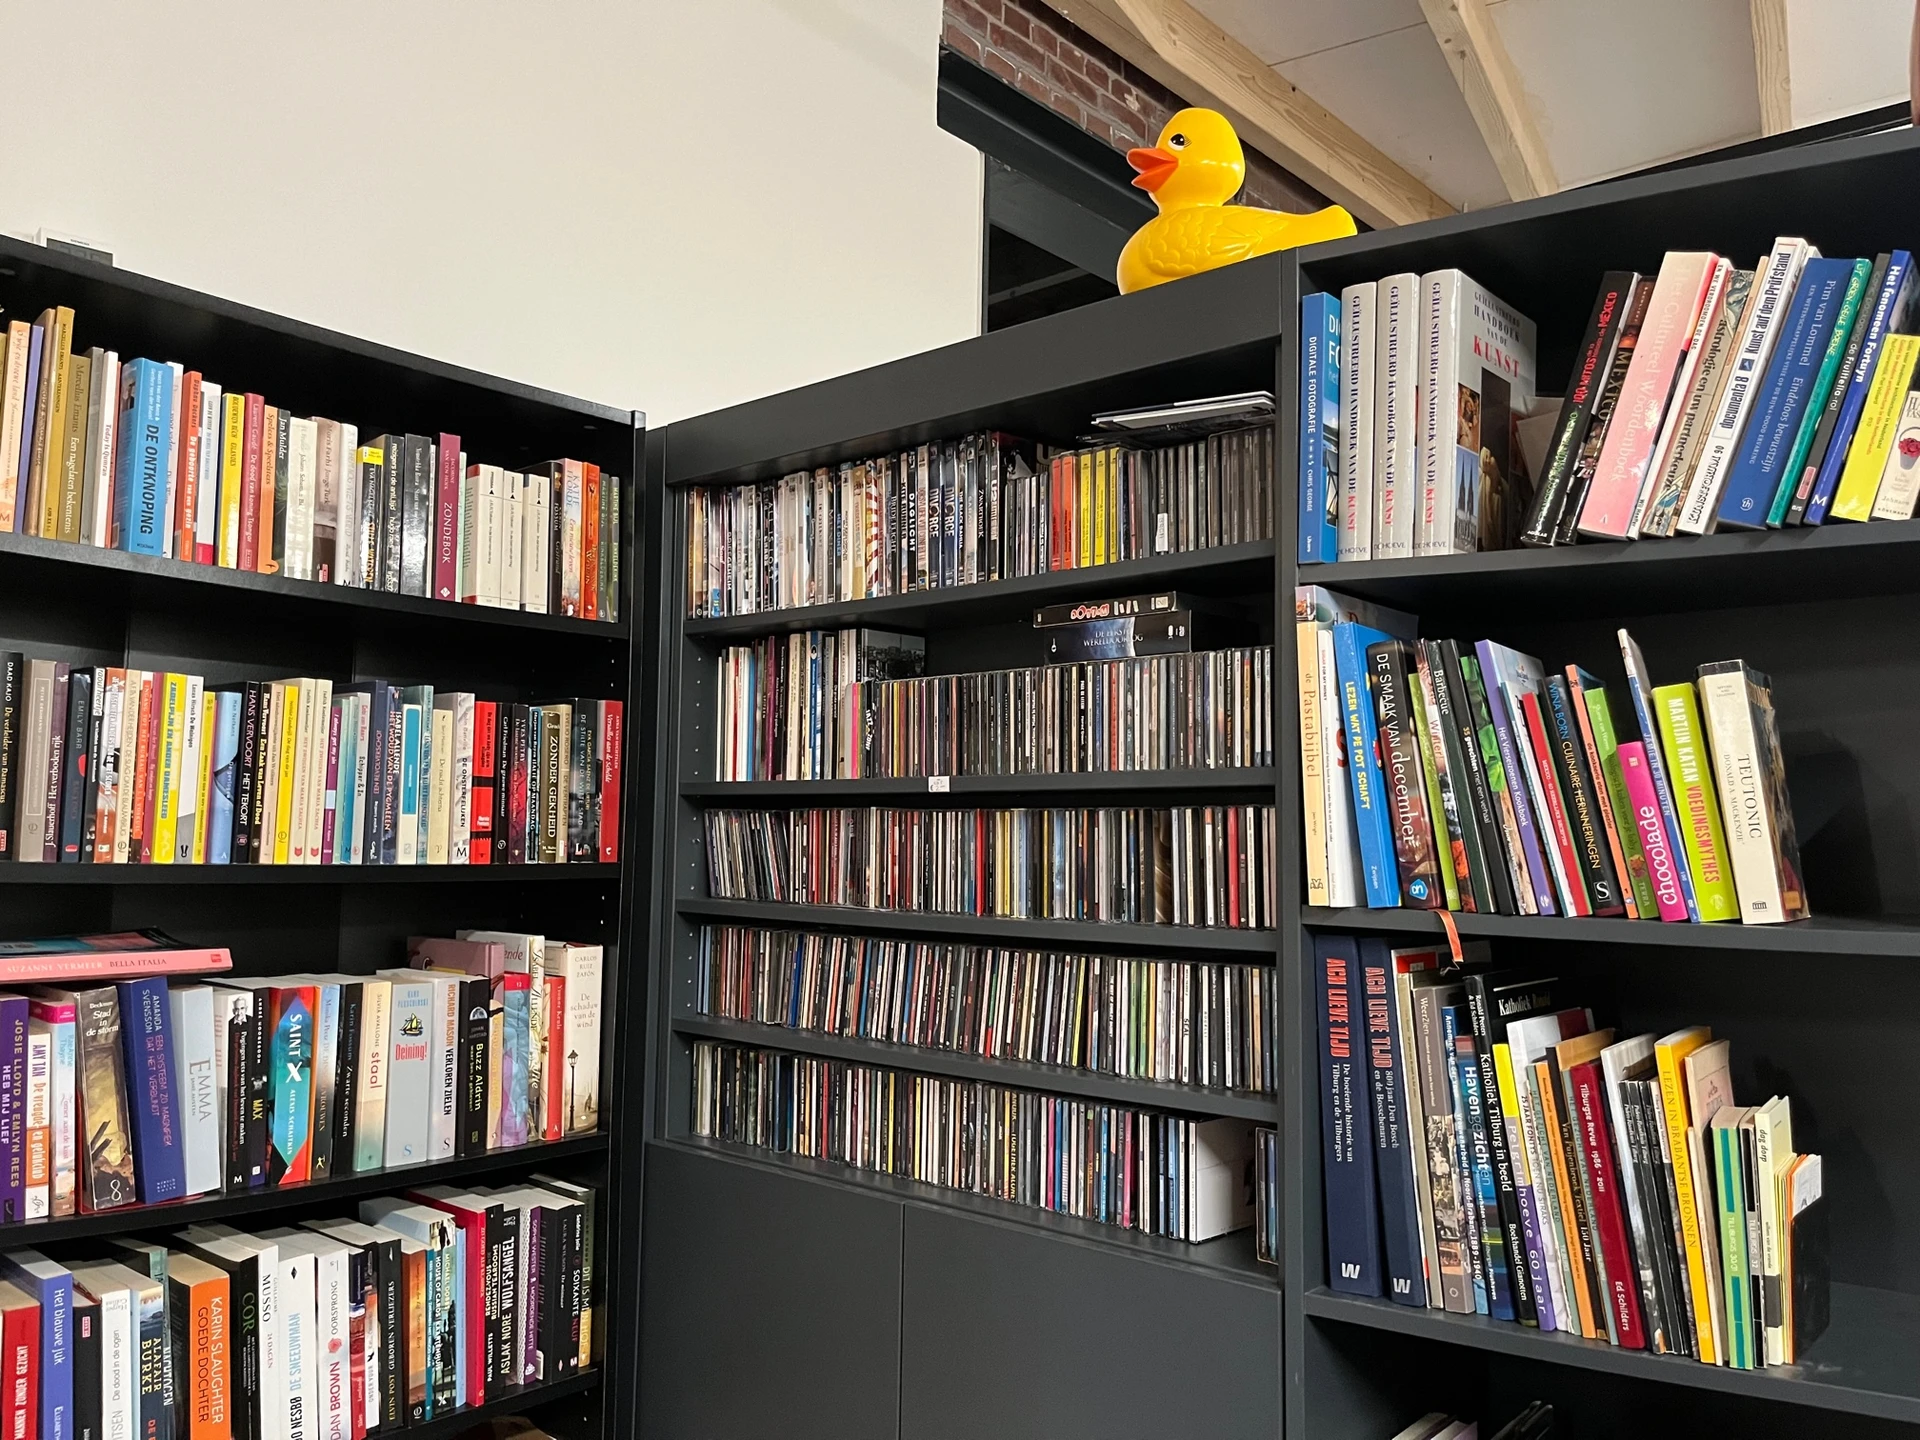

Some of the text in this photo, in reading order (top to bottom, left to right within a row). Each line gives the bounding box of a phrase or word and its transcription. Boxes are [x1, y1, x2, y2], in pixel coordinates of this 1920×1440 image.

[1744, 252, 1791, 354] Kunst auf dem Prüfstand
[1799, 280, 1837, 366] Pim van Lommel
[1855, 265, 1901, 383] Het fenomeen Fortuyn
[1307, 337, 1317, 433] DIGITALE FOTOGRAFIE
[1385, 286, 1400, 525] GEÏLLUSTREERD HANDBOEK VAN DE KUNST
[1426, 282, 1442, 525] GEÏLLUSTREERD HANDBOEK VAN DE KUNST
[1597, 351, 1630, 420] MEXICO
[1611, 267, 1692, 482] Het Cultureel Woordenboek
[1663, 320, 1728, 491] astrologie en uw partnerkeuze
[1719, 383, 1744, 429] documenta
[278, 418, 287, 459] Jan Mulder
[1347, 295, 1362, 532] GEÏLLUSTREERD HANDBOEK VAN DE KUNST
[1761, 377, 1803, 473] Eindeloos bewustzijn
[64, 437, 79, 534] Een nagelaten bekentenis
[139, 425, 159, 535] DE ONTKNOPING
[441, 502, 453, 563] ZONDEBOK
[1303, 673, 1320, 779] de Pastabijbel
[1433, 670, 1450, 715] Barbecue
[1549, 683, 1569, 739] WINA BORN
[75, 726, 83, 749] BARR
[244, 690, 257, 768] HANS VERVOORT
[1345, 681, 1370, 809] LEZEN WAT DE POT SCHAFT
[1375, 653, 1419, 845] DE SMAAK VAN december
[1429, 719, 1444, 759] Winter!
[1667, 698, 1698, 782] MARTIJN KATAN
[240, 773, 251, 825] HET TEKORT
[548, 736, 559, 837] ZONDER GEKHEID
[1498, 727, 1529, 827] Het Vierseizoenen Kookboek
[1562, 741, 1601, 869] CULINAIRE HERINNERINGEN
[1737, 754, 1762, 839] TEUTONIC
[1640, 806, 1678, 905] chocolade
[1687, 786, 1719, 883] VOEDINGSMYTHES
[14, 1019, 23, 1054] JOSIE
[142, 989, 153, 1033] SVENSSON
[153, 995, 162, 1031] AMANDA
[288, 1014, 301, 1057] SAINT
[446, 984, 455, 1046] RICHARD MASON
[1327, 958, 1351, 1058] ACH LIEVE TIJD
[1365, 967, 1393, 1068] ACH LIEVE TIJD
[2, 1066, 11, 1090] HEB
[13, 1059, 22, 1096] LLOYD
[32, 1045, 46, 1077] AMY TAN
[370, 1052, 382, 1089] staal
[395, 1042, 428, 1060] Deining!
[443, 1048, 453, 1115] VERLOREN ZIELEN
[474, 1043, 484, 1110] Buzz Aldrin
[2, 1093, 10, 1115] MIJ
[189, 1059, 211, 1122] EMMA
[253, 1099, 263, 1120] MAX
[1464, 1066, 1493, 1186] Havengezichten
[1480, 1054, 1512, 1191] Katholiek Tilburg in beeld
[12, 1114, 20, 1152] EMLYN
[1579, 1083, 1606, 1193] Tilburgse Revue 1986 2011
[1662, 1071, 1697, 1248] LEZEN IN BRABANTSE BRONNEN
[11, 1157, 20, 1187] REES
[1507, 1125, 1548, 1315] Pelgrimhoeve 60 jaar
[502, 1236, 515, 1309] WOLFSANGEL
[1508, 1223, 1528, 1300] Boekhandel Gianotten
[53, 1289, 65, 1365] Het blauwe juk
[242, 1291, 255, 1333] COR
[262, 1274, 271, 1323] MUSSO
[330, 1281, 339, 1335] OORSPRONG
[1615, 1281, 1631, 1331] Ed Schilders
[142, 1340, 152, 1395] BURKE
[153, 1338, 162, 1392] ALAFAIR
[198, 1307, 209, 1422] GOEDE DOCHTER
[211, 1297, 223, 1424] KARIN SLAUGHTER
[501, 1313, 512, 1374] ASLAK NORE
[290, 1397, 301, 1429] NESBØ
[329, 1361, 340, 1411] BROWN
